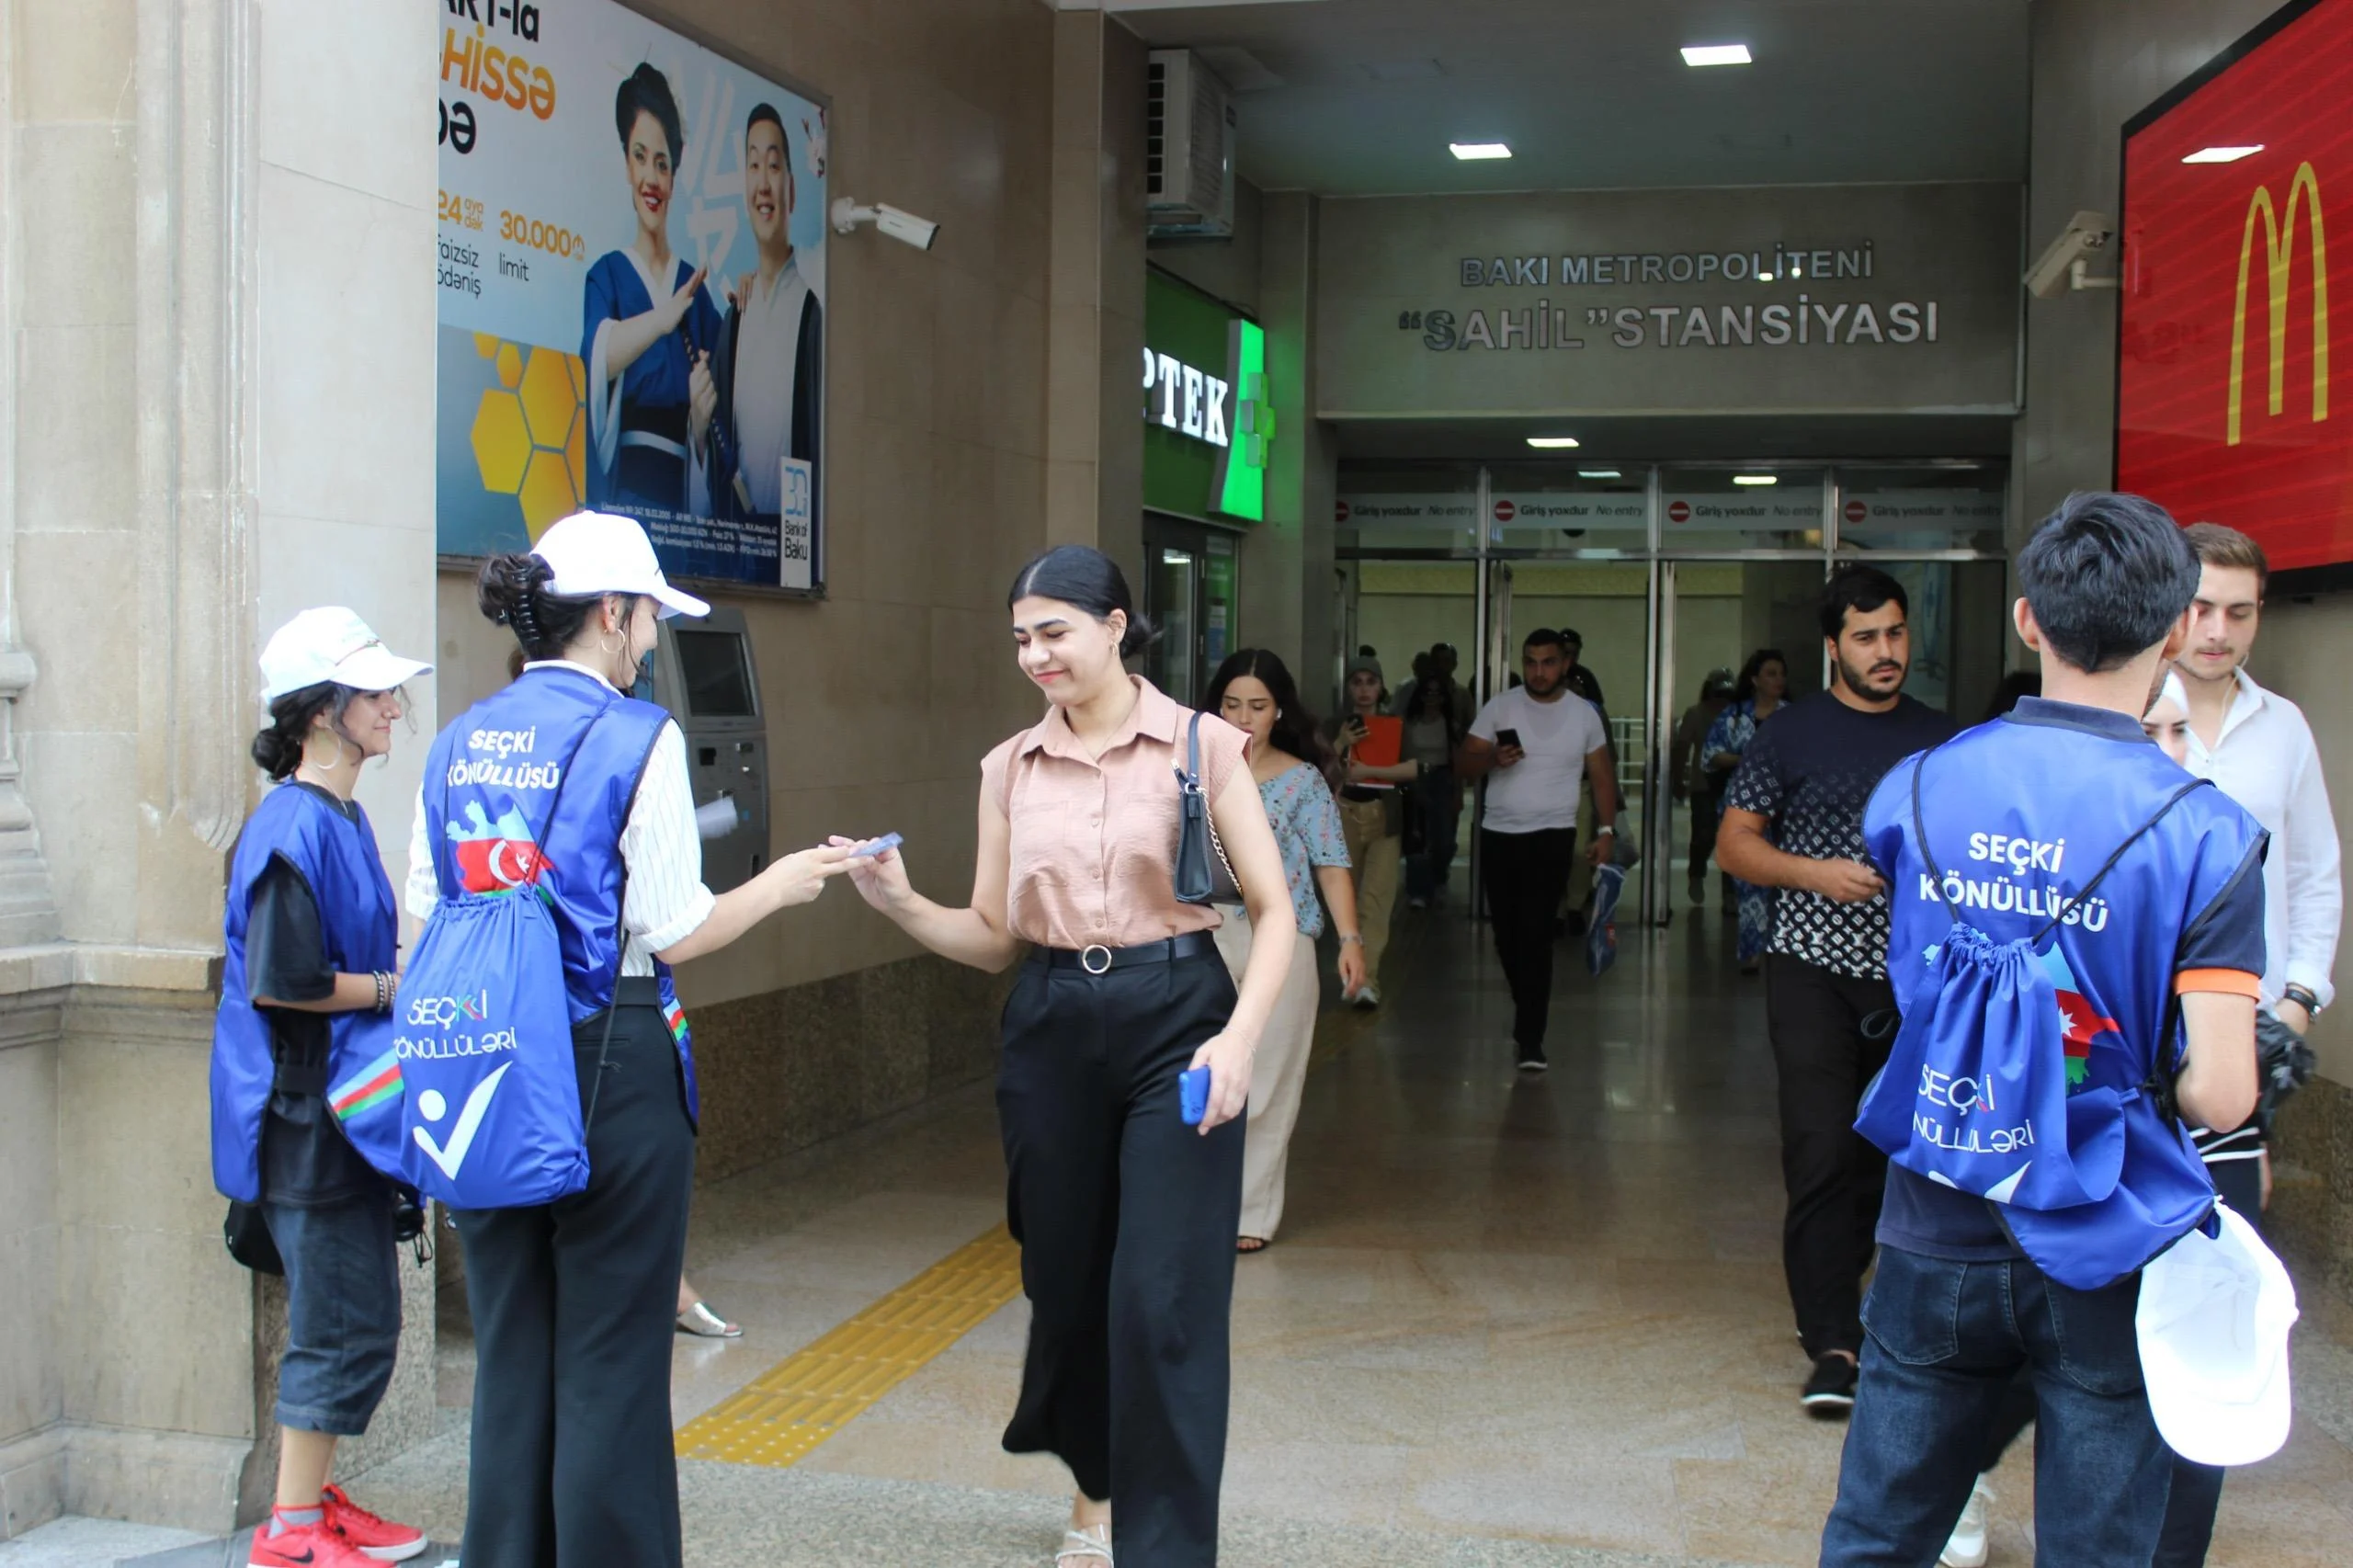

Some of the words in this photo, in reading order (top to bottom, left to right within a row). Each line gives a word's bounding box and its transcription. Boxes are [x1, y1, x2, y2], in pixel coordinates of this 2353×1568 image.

[499, 252, 529, 281] limit
[1461, 256, 1549, 286] BAKI
[1563, 240, 1874, 284] METROPOLİTENİ
[1520, 505, 1546, 517] Giriş
[1548, 505, 1589, 517] yoxdur
[1597, 506, 1612, 516] No
[1614, 506, 1643, 517] entry
[1696, 505, 1722, 517] Giriş
[1724, 505, 1766, 517] yoxdur
[1773, 506, 1790, 516] No
[1791, 506, 1823, 517] entry
[785, 537, 808, 561] Baku
[468, 725, 536, 759] SEÇKİ
[1968, 832, 2065, 875] SEÇKİ
[1919, 869, 2109, 933] KÖNÜLLÜSÜ
[393, 1026, 517, 1059] ÖNÜLLÜLƏRİ
